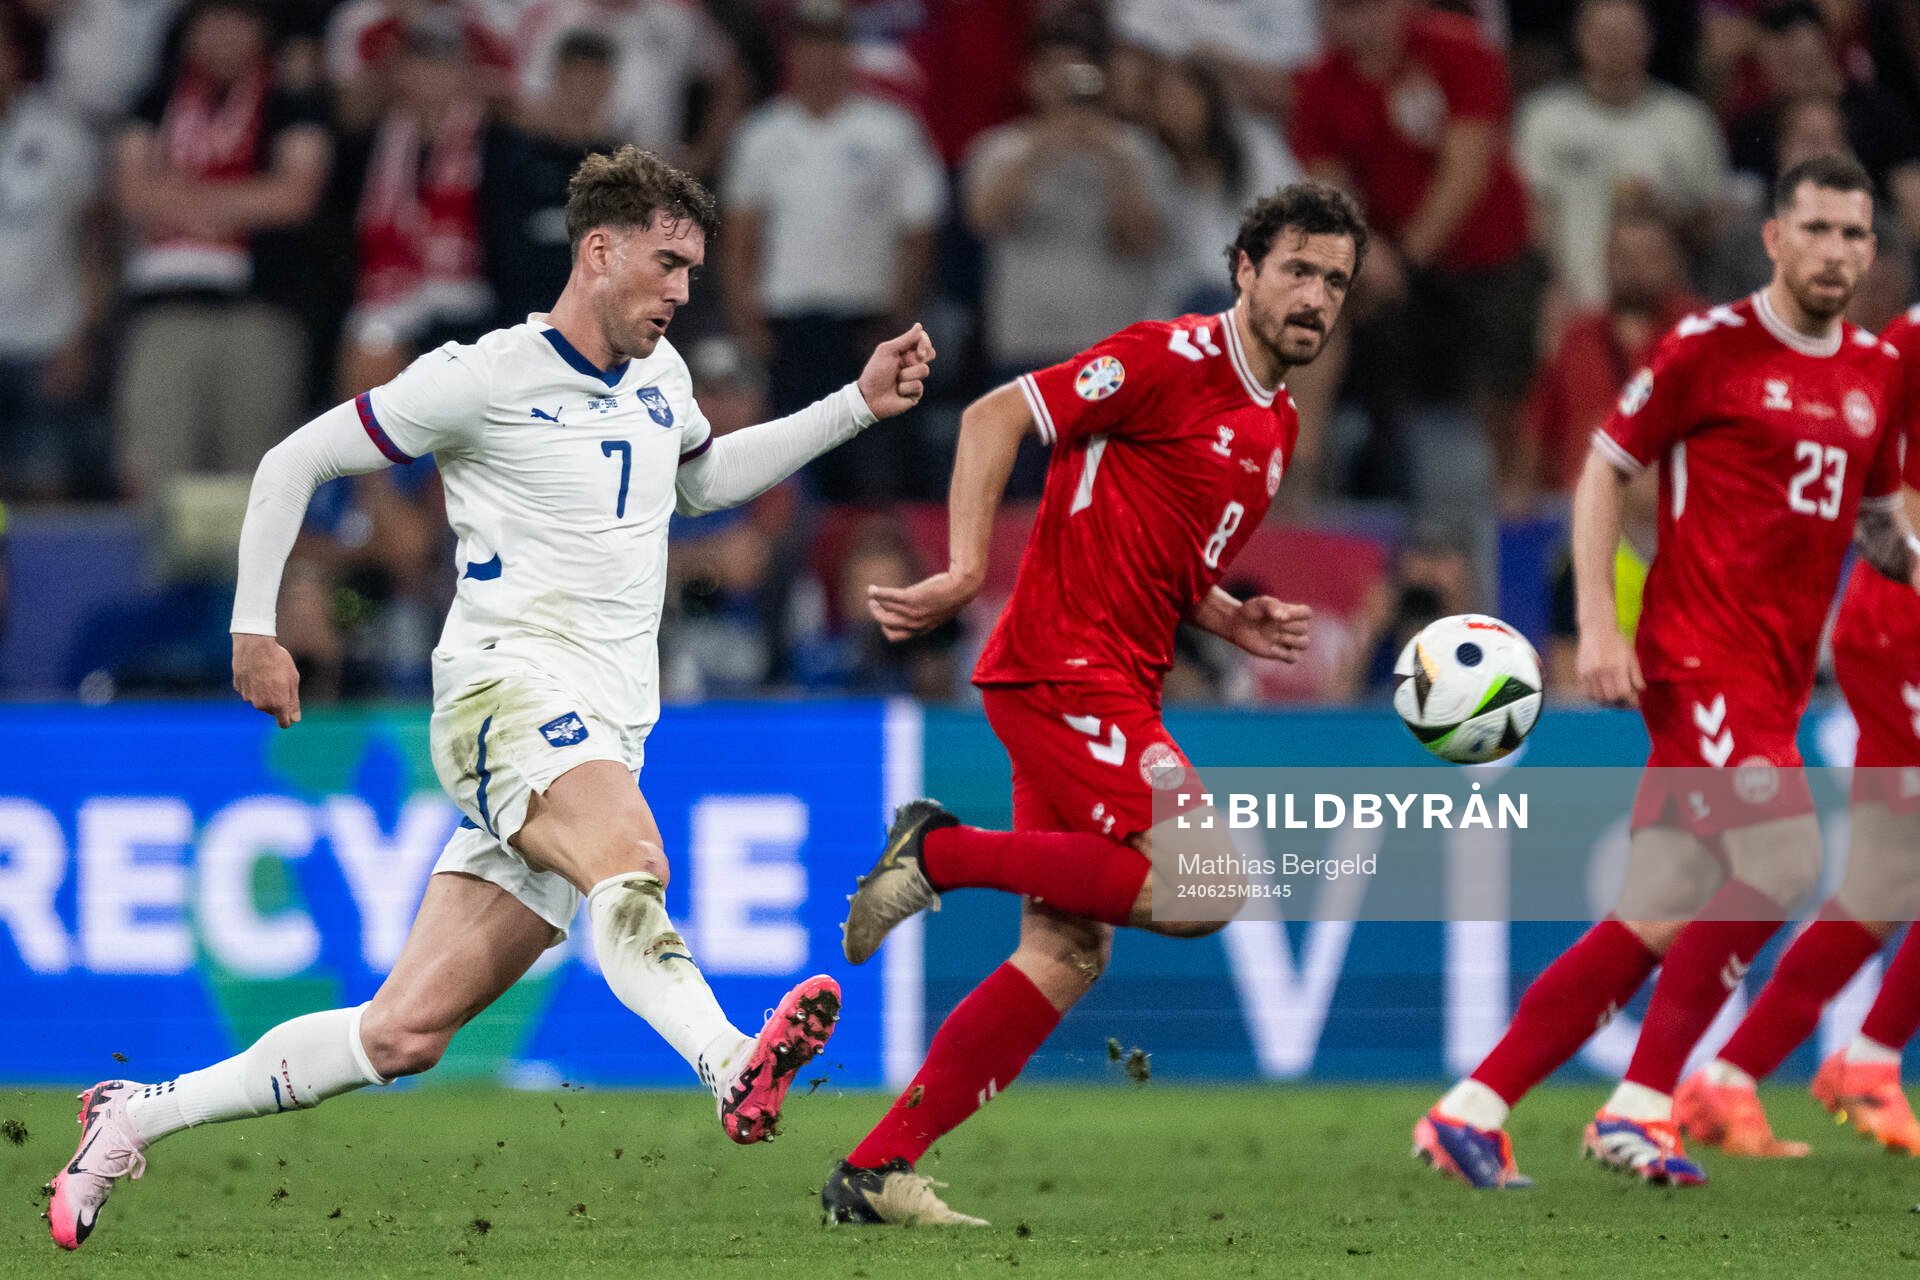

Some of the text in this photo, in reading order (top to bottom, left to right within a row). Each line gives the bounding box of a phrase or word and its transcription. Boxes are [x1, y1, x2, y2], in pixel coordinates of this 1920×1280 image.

[600, 440, 632, 519] 7
[1788, 440, 1848, 521] 23
[1204, 501, 1245, 569] 8
[0, 794, 811, 977] RECYE
